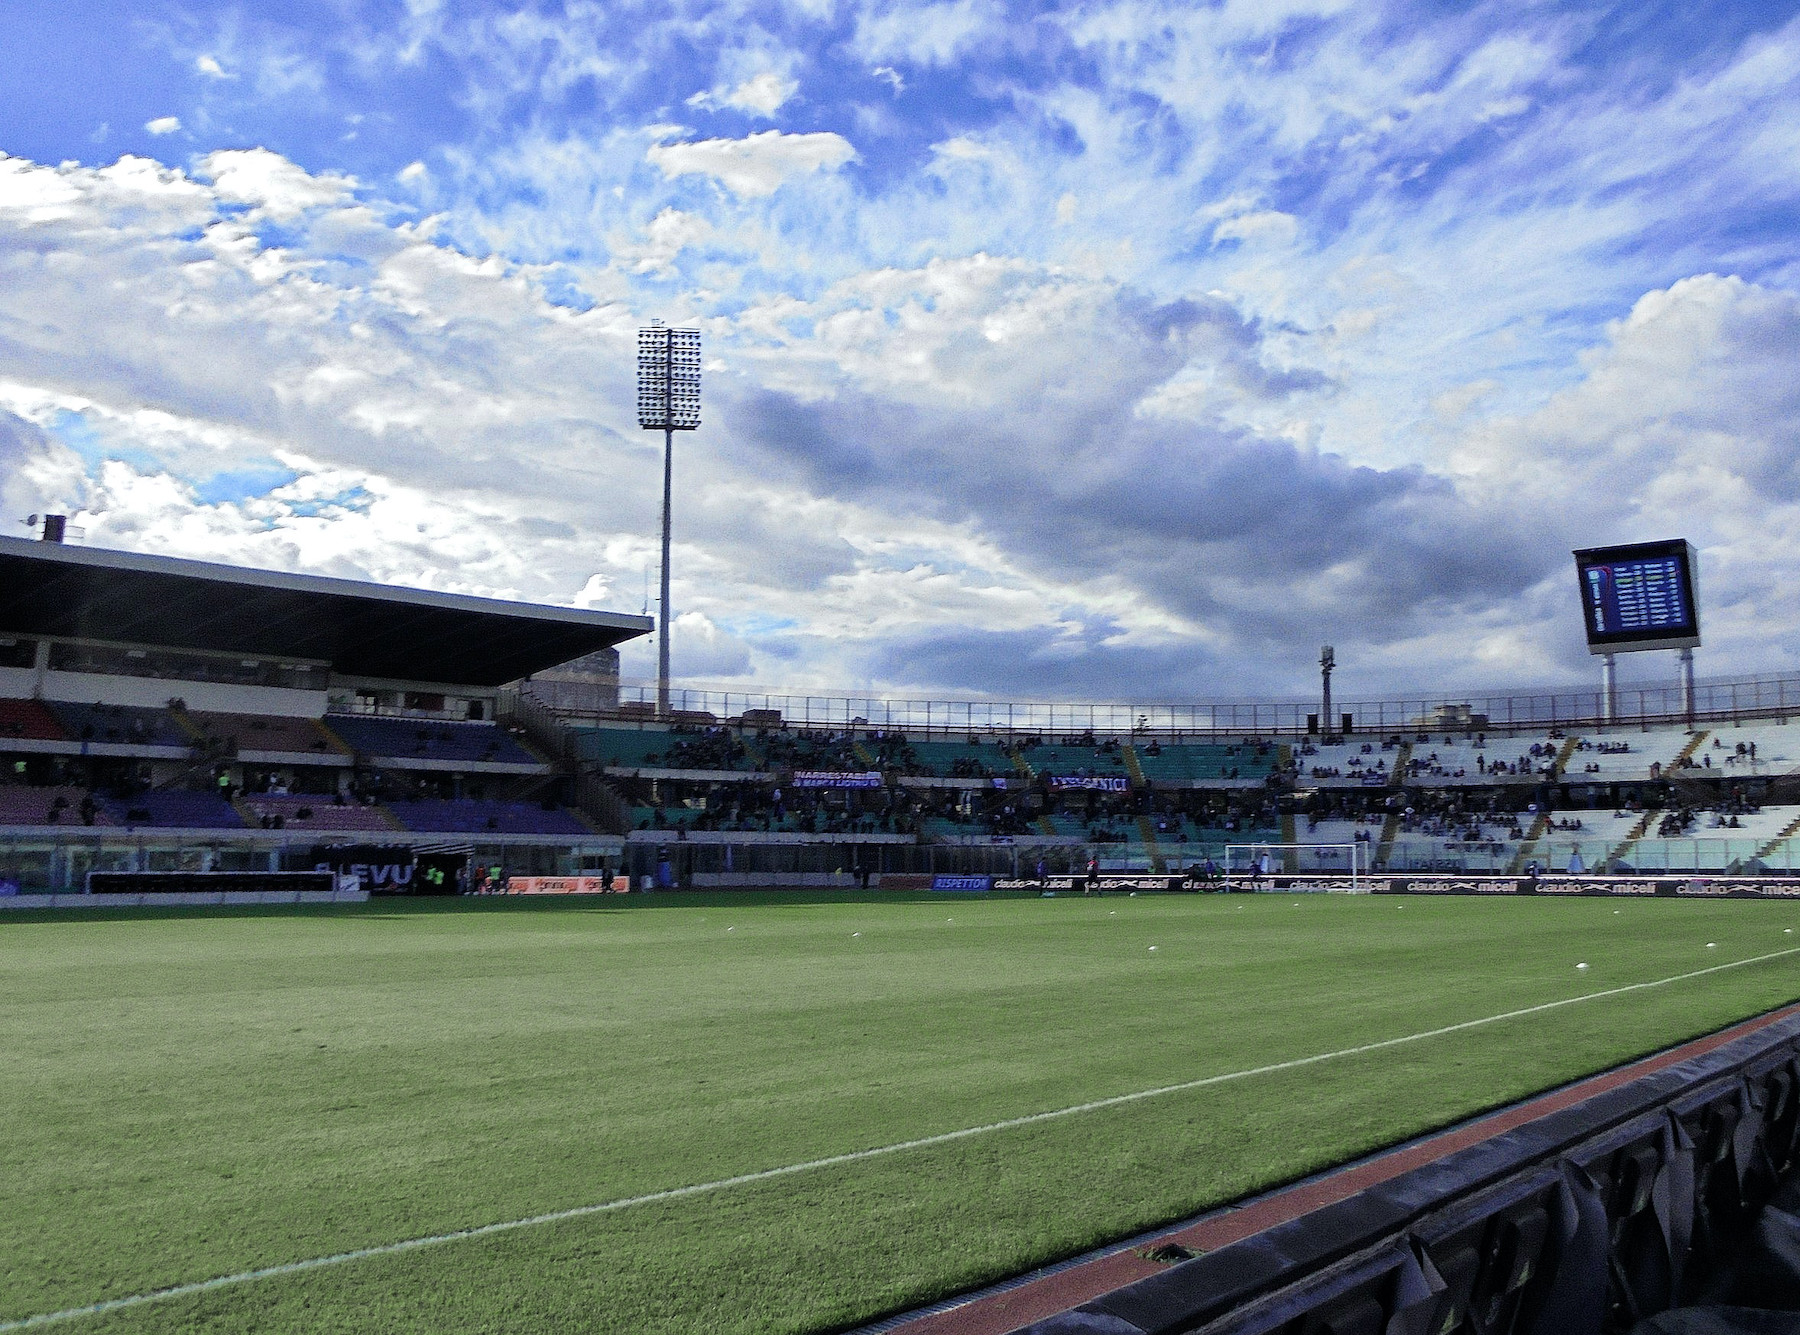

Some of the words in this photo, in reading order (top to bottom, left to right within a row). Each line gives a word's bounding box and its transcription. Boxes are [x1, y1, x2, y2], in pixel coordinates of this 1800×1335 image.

[1407, 881, 1450, 891] claudio
[1476, 881, 1518, 891] miceli
[1612, 882, 1656, 893] miceli
